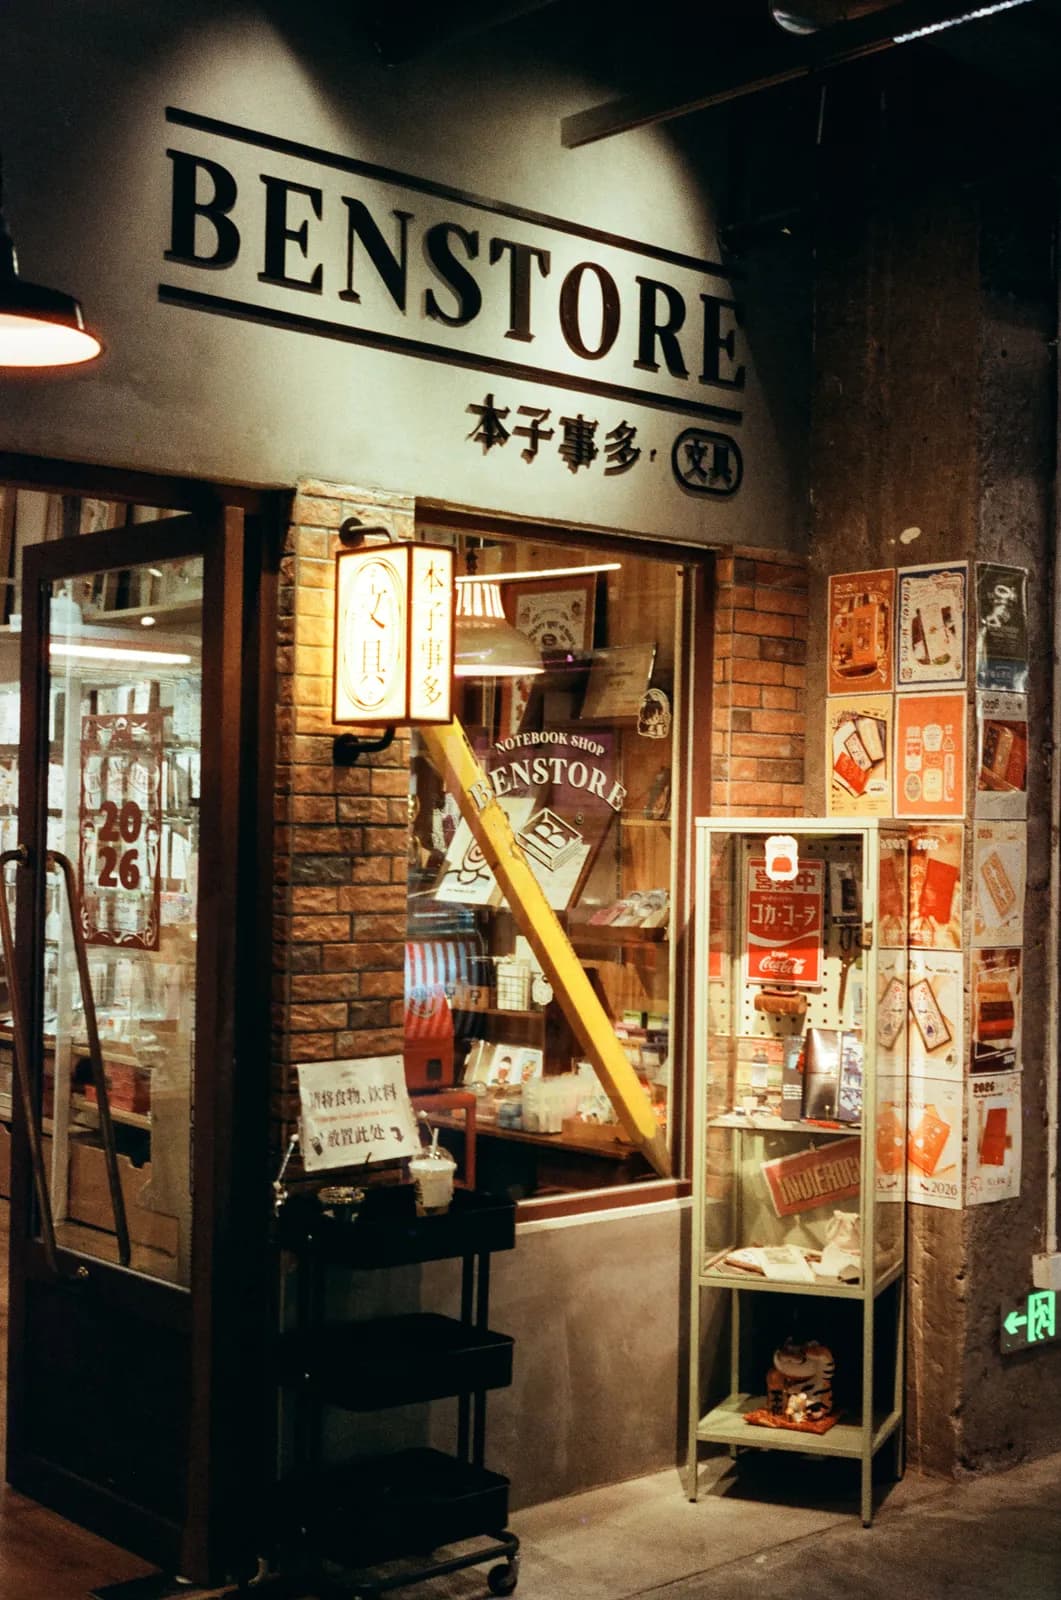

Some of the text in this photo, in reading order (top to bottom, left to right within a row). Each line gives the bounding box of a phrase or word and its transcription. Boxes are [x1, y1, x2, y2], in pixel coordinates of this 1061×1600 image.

[164, 148, 746, 390] BENSTORE
[684, 439, 733, 488] 文具
[494, 731, 605, 757] NOTEBOOK SHOP
[470, 757, 628, 812] BENSTORE
[751, 903, 817, 927] コカ・コーラ
[931, 1181, 958, 1197] 2026
